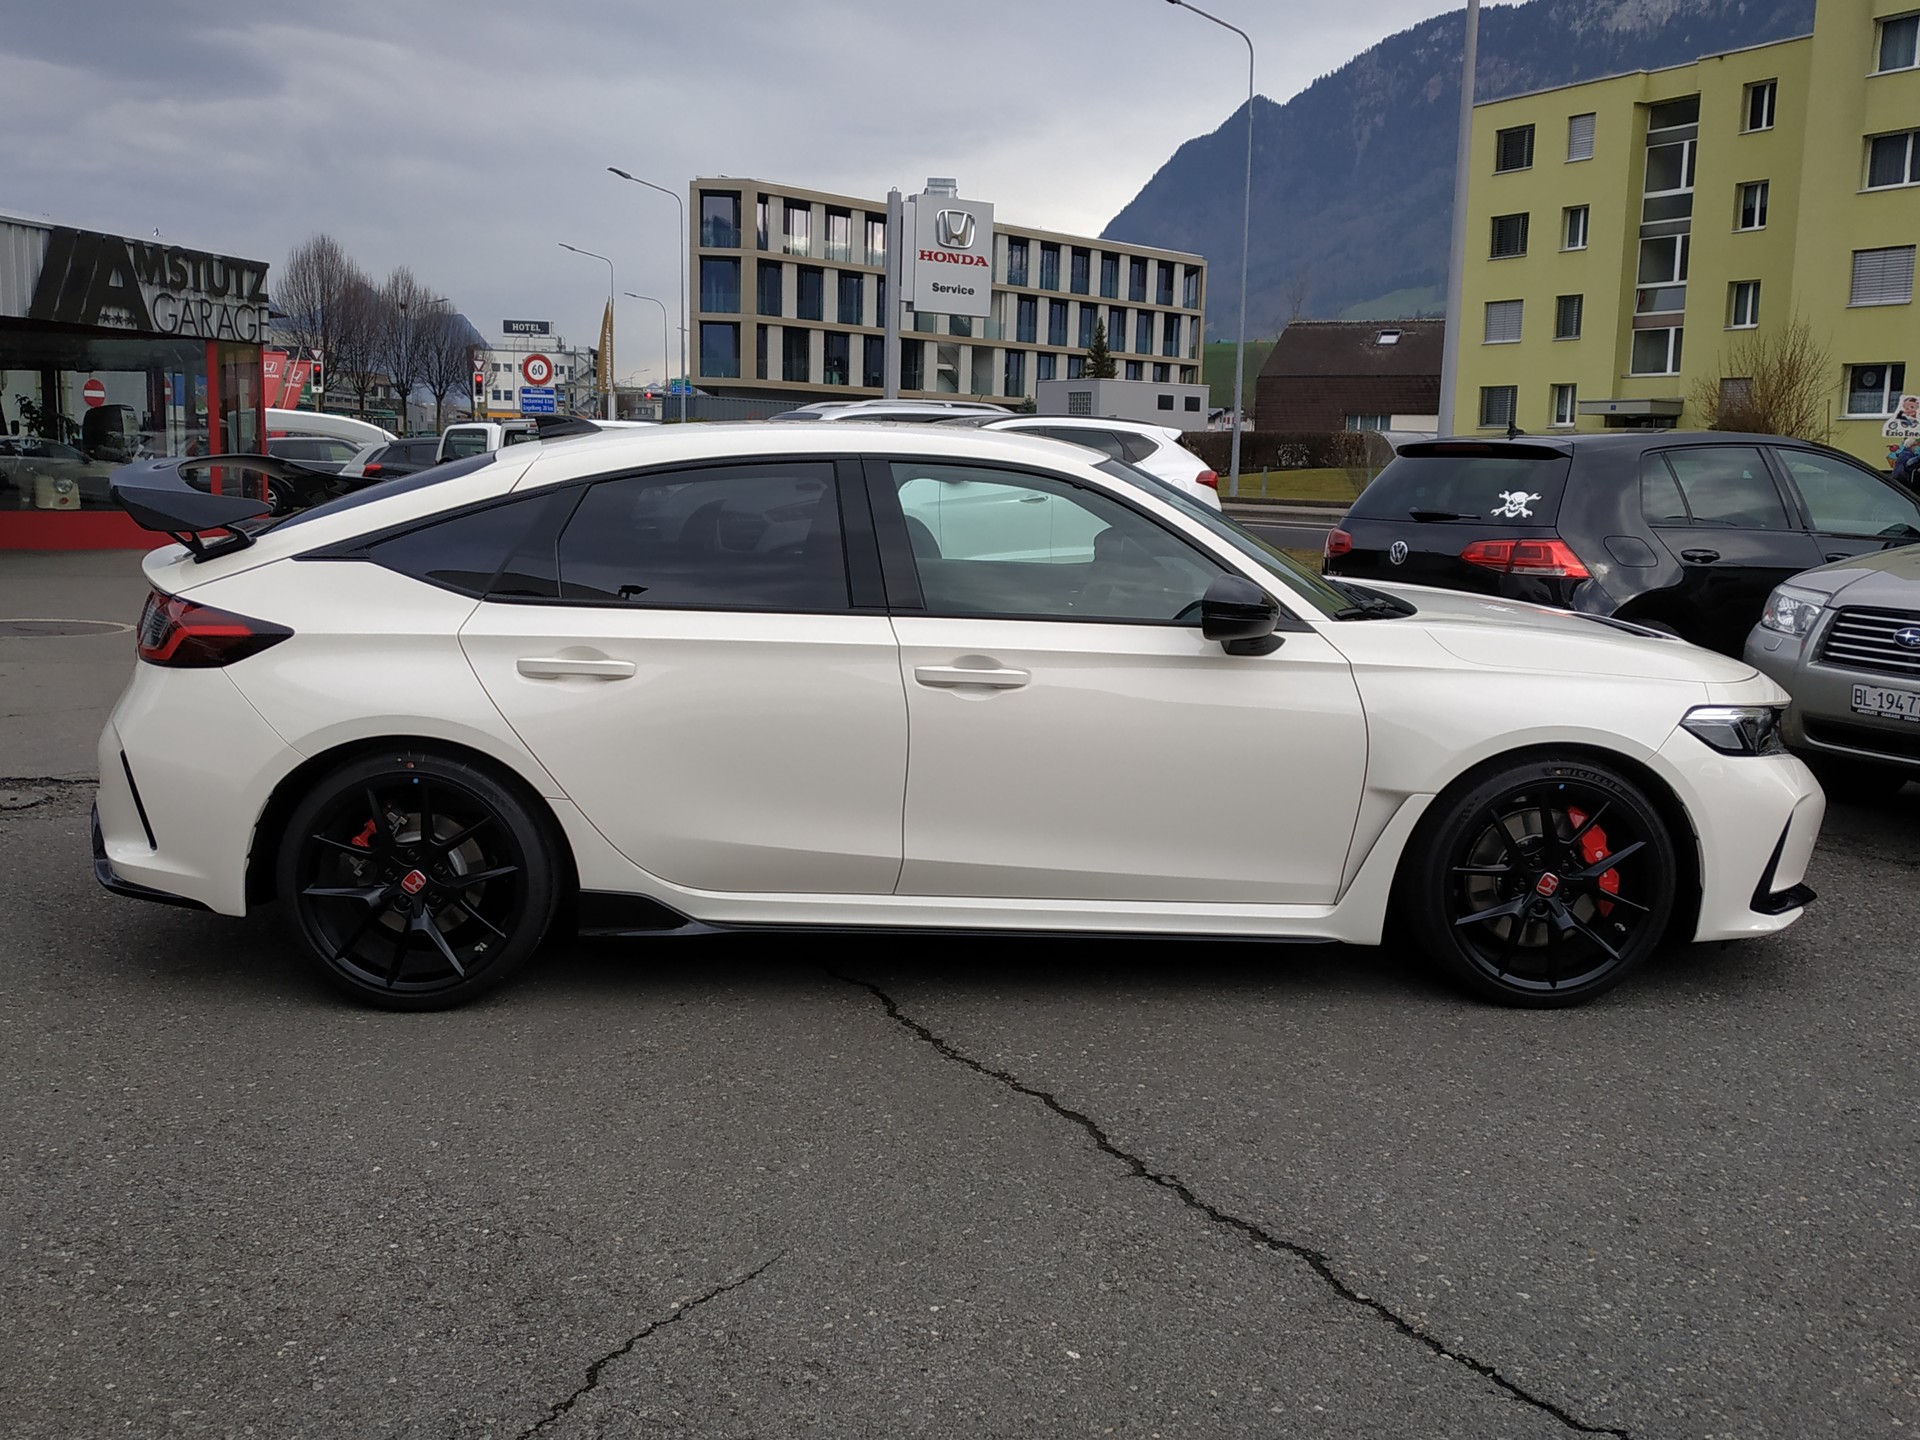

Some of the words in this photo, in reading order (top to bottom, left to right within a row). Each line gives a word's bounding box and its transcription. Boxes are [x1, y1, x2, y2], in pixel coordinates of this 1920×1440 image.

[919, 250, 989, 267] HONDA
[932, 282, 975, 295] Service
[153, 292, 270, 345] GARAGE
[512, 323, 541, 331] HOTEL
[531, 364, 543, 375] 60
[1562, 768, 1623, 793] MICHELIN
